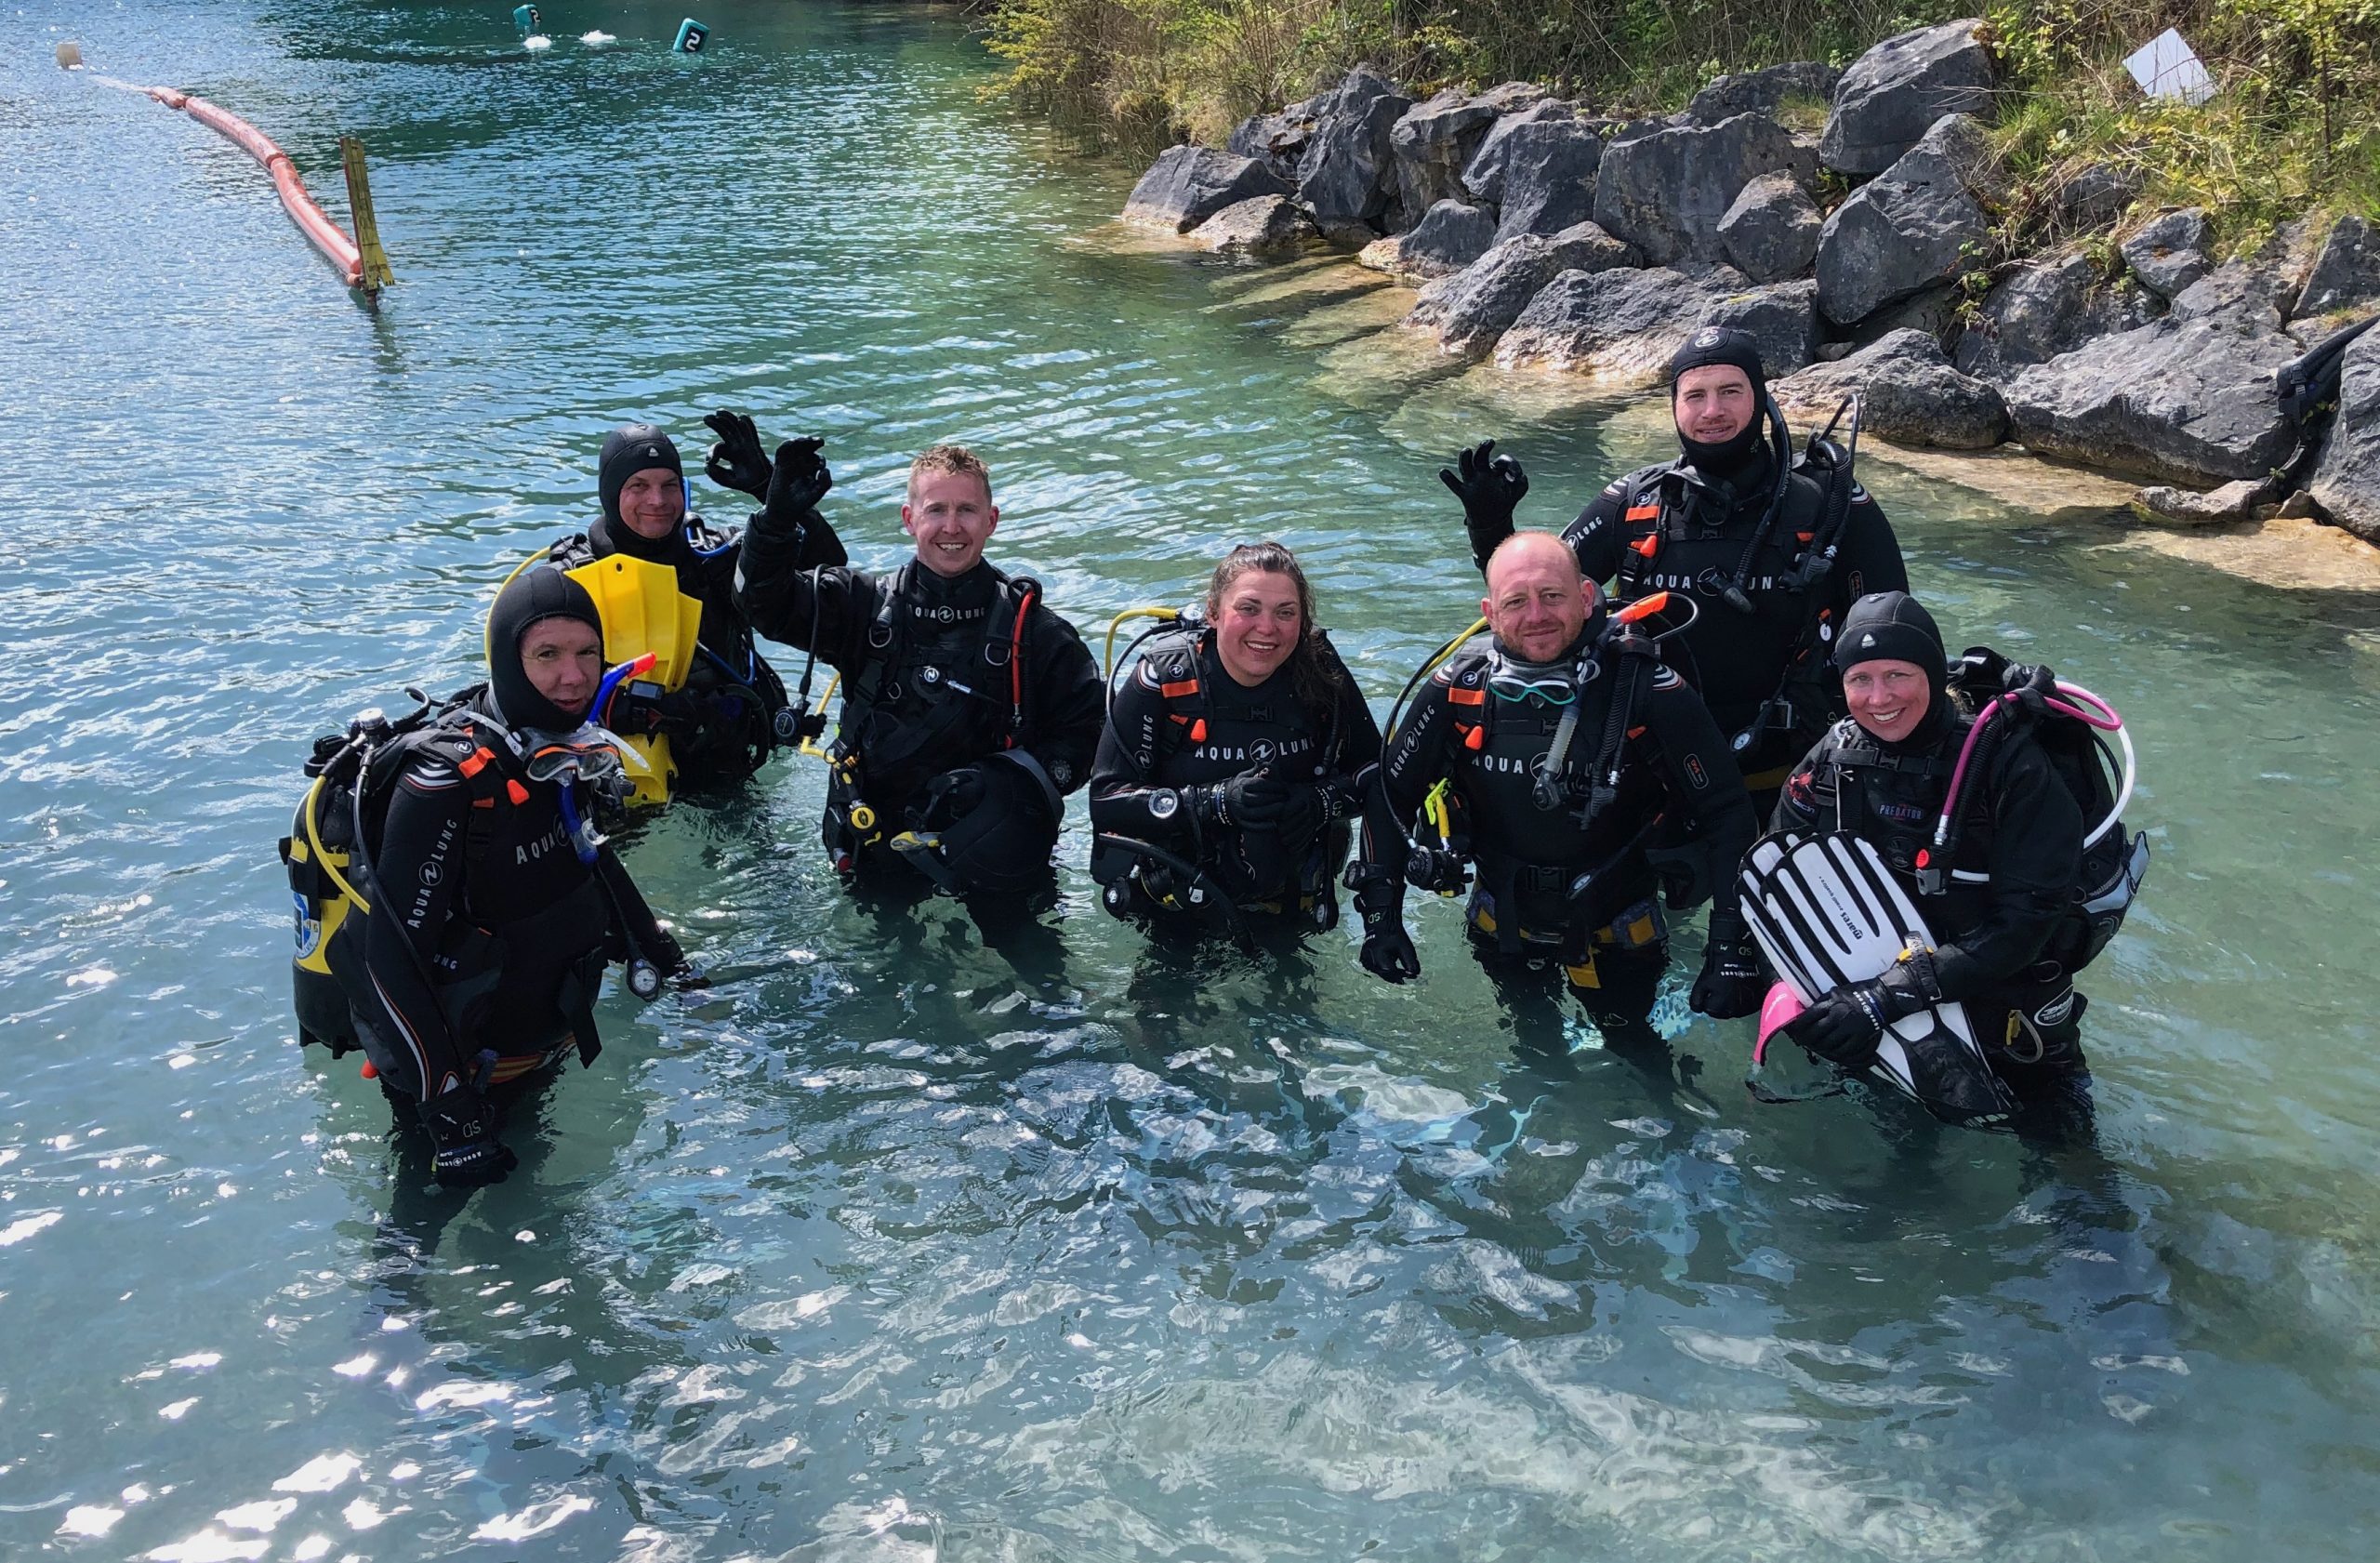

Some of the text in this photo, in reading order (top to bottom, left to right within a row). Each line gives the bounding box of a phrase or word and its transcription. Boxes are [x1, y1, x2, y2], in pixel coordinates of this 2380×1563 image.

[685, 32, 701, 51] 2
[1577, 516, 1603, 540] LUNG
[1643, 574, 1691, 589] AQUA
[1141, 714, 1154, 750] LUNG
[1390, 704, 1435, 778] AQUA LUNG
[1194, 745, 1245, 761] AQUA
[1472, 755, 1525, 775] AQUA
[1879, 804, 1922, 819] PREDATOR
[515, 831, 556, 865] AQUA
[407, 818, 458, 929] AQUA LUNG
[1841, 911, 1863, 939] mares
[433, 953, 458, 970] UNG
